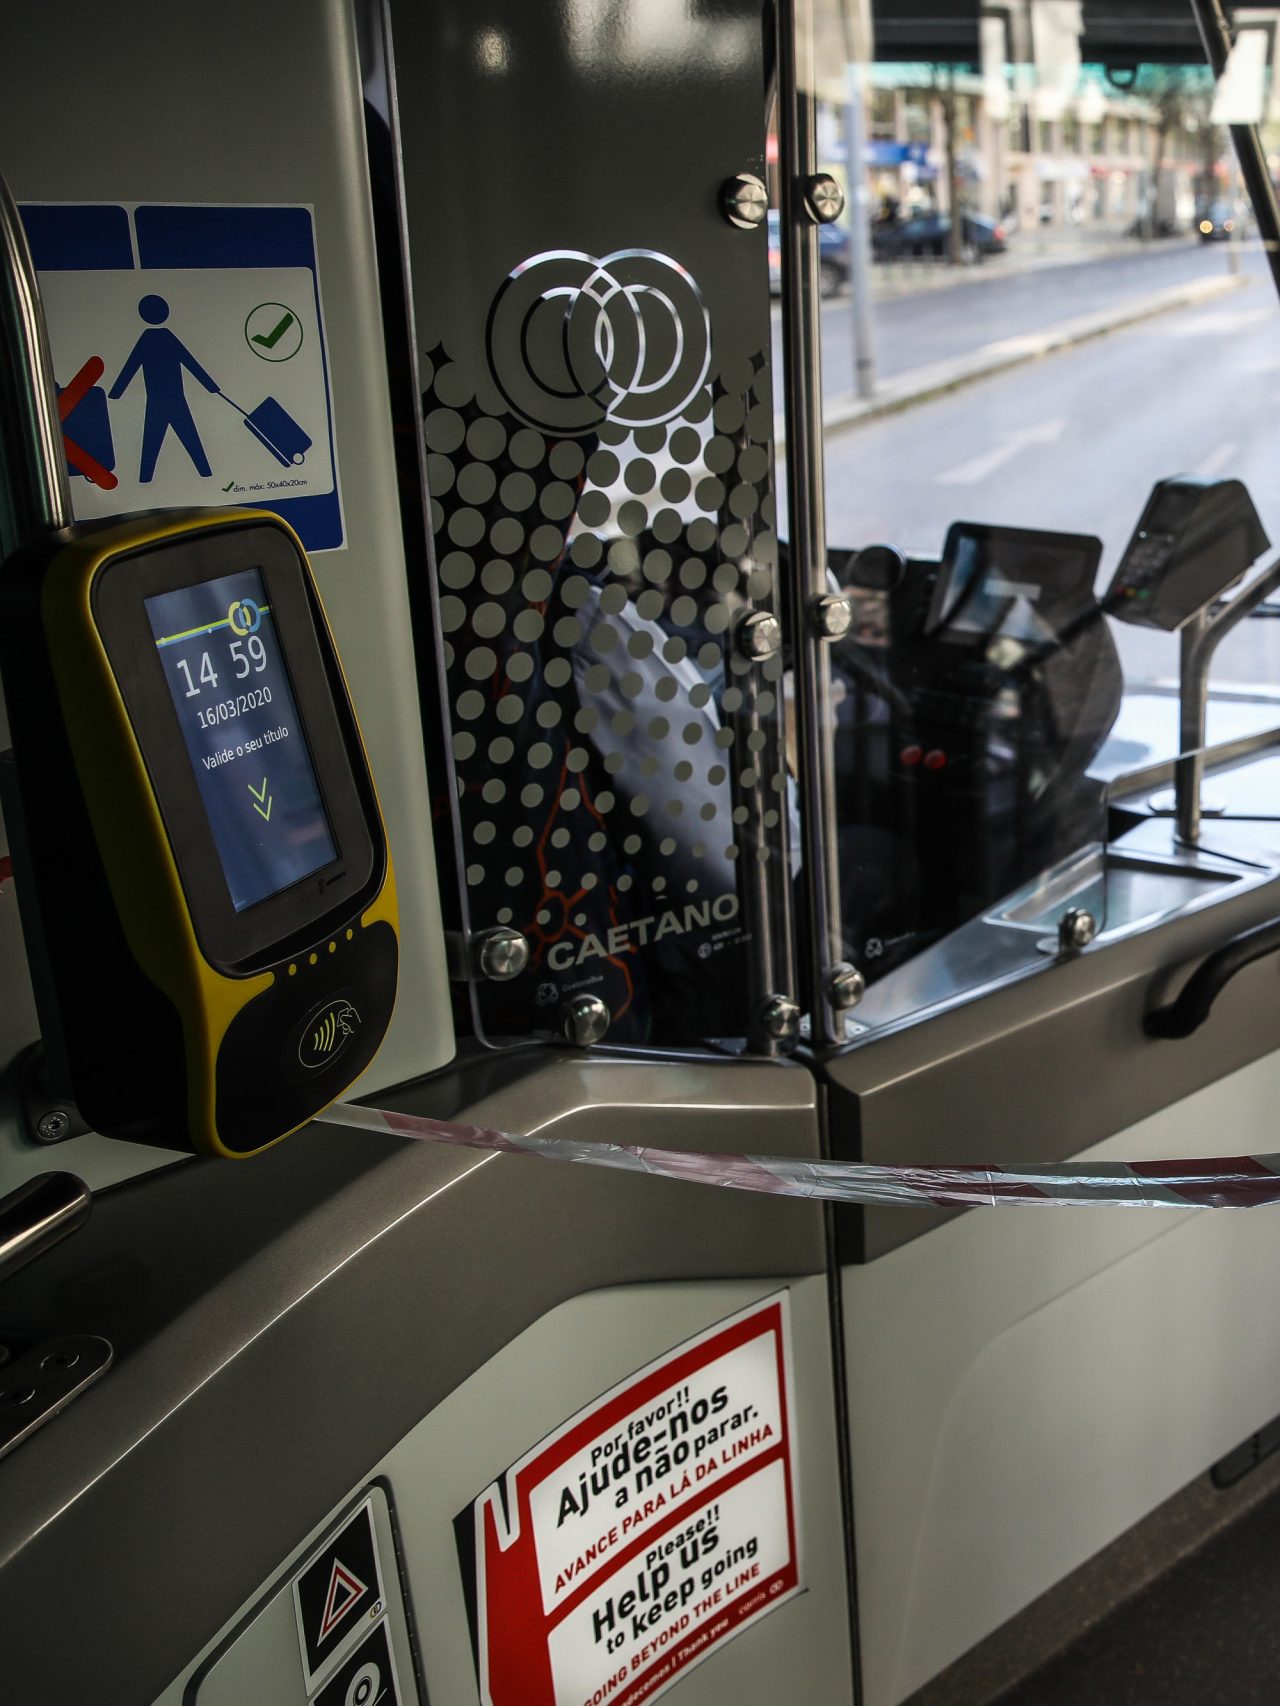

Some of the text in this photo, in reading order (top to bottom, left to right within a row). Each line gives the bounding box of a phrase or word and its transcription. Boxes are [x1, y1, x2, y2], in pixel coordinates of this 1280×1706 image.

[266, 480, 308, 490] 50x40x20cm
[177, 635, 267, 698] 14 59
[197, 686, 272, 729] 16/03/2020
[202, 726, 289, 770] Valide o seu título
[547, 893, 740, 972] CAETANO
[556, 1385, 730, 1529] Ajude-nos
[590, 1385, 691, 1468] Por favor!!
[615, 1404, 759, 1509] a não parar.
[554, 1423, 774, 1595] AVANCE PARA LÁ DA LINHA
[645, 1503, 721, 1572] Please!!
[591, 1525, 720, 1645] Help us
[606, 1535, 759, 1655] to keep going
[630, 1613, 690, 1672] BEYOND
[692, 1588, 723, 1619] THE
[724, 1561, 761, 1597] LINE
